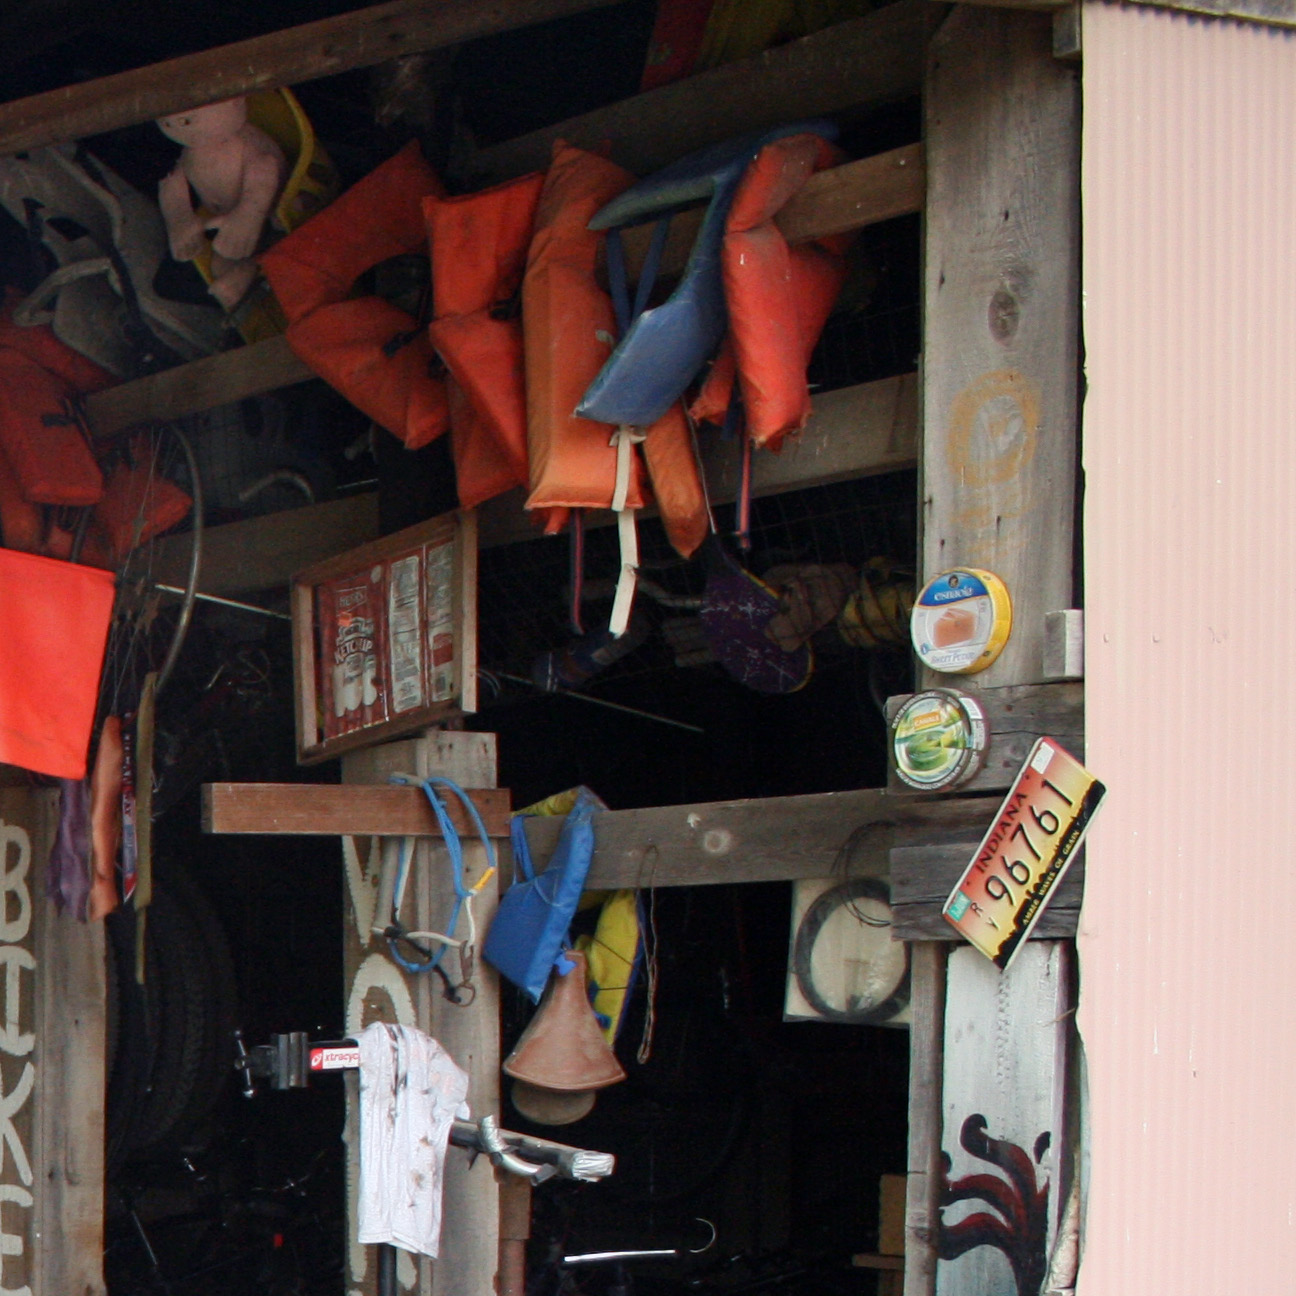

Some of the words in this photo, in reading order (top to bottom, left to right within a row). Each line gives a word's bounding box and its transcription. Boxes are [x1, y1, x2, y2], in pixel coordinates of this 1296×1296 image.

[974, 792, 1027, 874] INDIANA
[985, 778, 1076, 907] 96761
[1022, 898, 1041, 925] AMBER
[1039, 871, 1056, 897] WAVES
[1062, 829, 1082, 855] GRAIN
